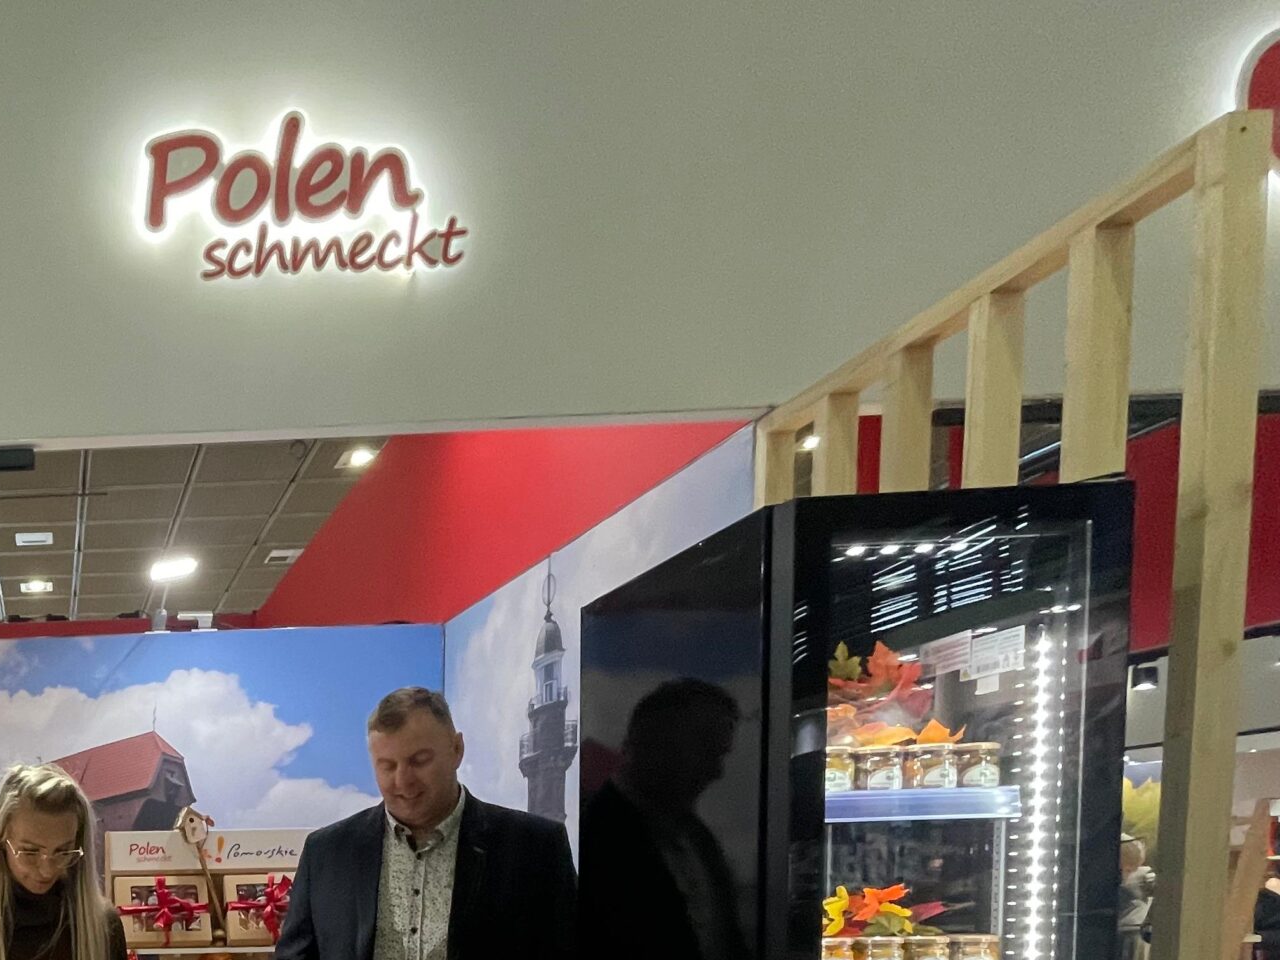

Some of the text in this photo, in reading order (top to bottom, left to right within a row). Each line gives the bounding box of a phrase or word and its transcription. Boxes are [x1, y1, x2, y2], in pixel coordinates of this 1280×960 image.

[145, 111, 424, 232] Polen
[201, 216, 469, 281] schmeckt
[129, 842, 166, 856] Polen
[227, 843, 298, 858] Pomorskie
